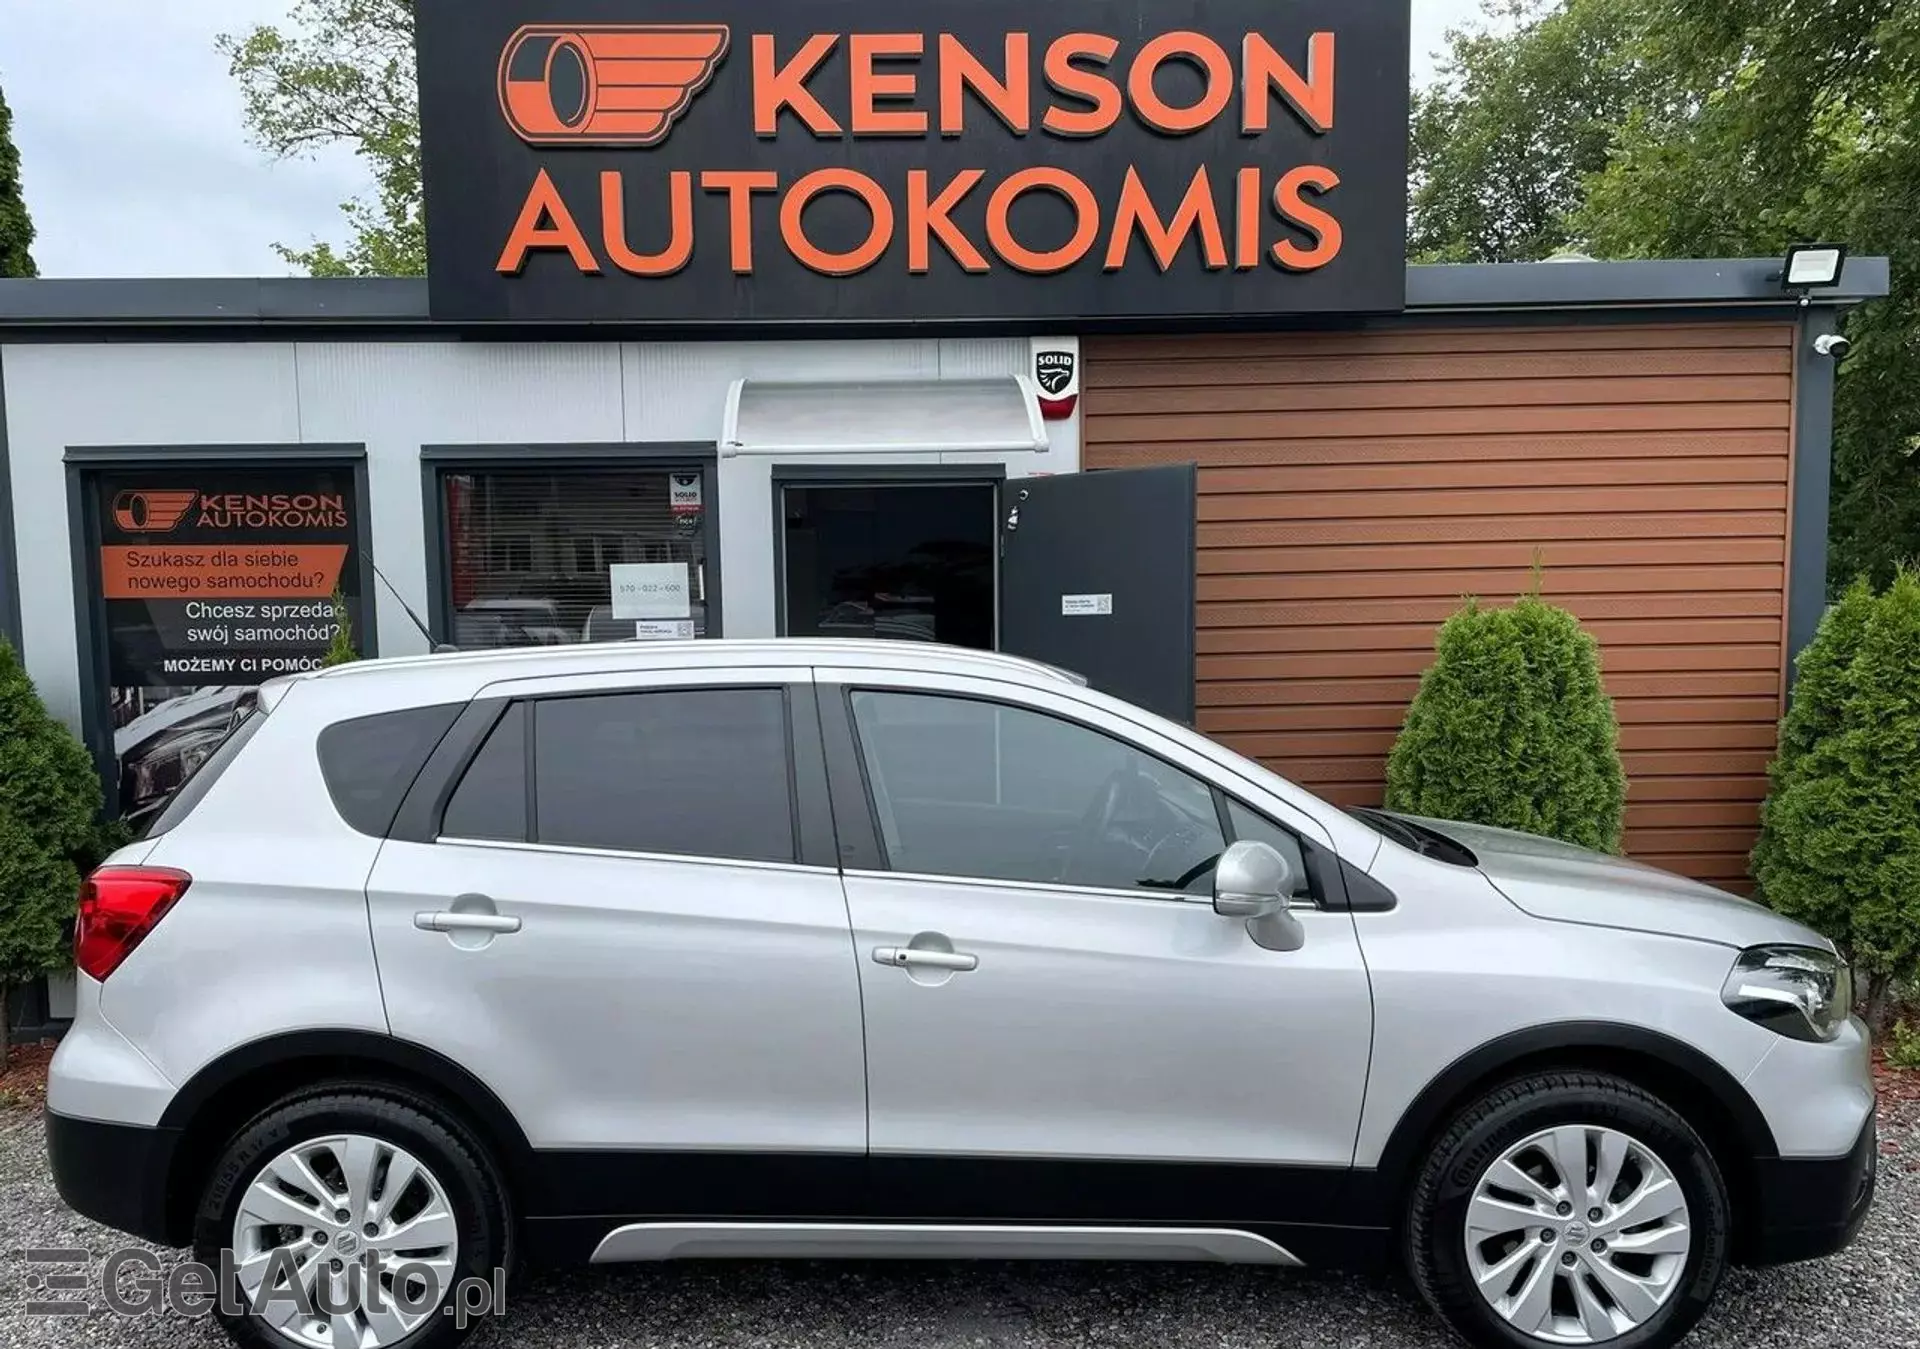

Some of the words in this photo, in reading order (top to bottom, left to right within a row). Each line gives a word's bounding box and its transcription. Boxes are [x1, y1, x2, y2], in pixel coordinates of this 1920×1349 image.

[752, 31, 1335, 137] KENSON
[495, 163, 1344, 277] AUTOKOMIS
[1038, 354, 1072, 366] SOLID
[200, 494, 342, 510] KENSON
[196, 510, 348, 528] AUTOKOMIS
[127, 551, 205, 567] Szukasz
[211, 551, 238, 567] dla
[245, 550, 298, 566] siebie
[128, 576, 201, 592] nowego
[207, 572, 324, 589] samochodu?
[186, 602, 255, 619] Chcesz
[187, 626, 229, 645] swój
[234, 624, 340, 641] samochód?
[164, 658, 238, 672] MOŻEMY
[240, 659, 257, 671] CI
[262, 657, 323, 671] POMÓC
